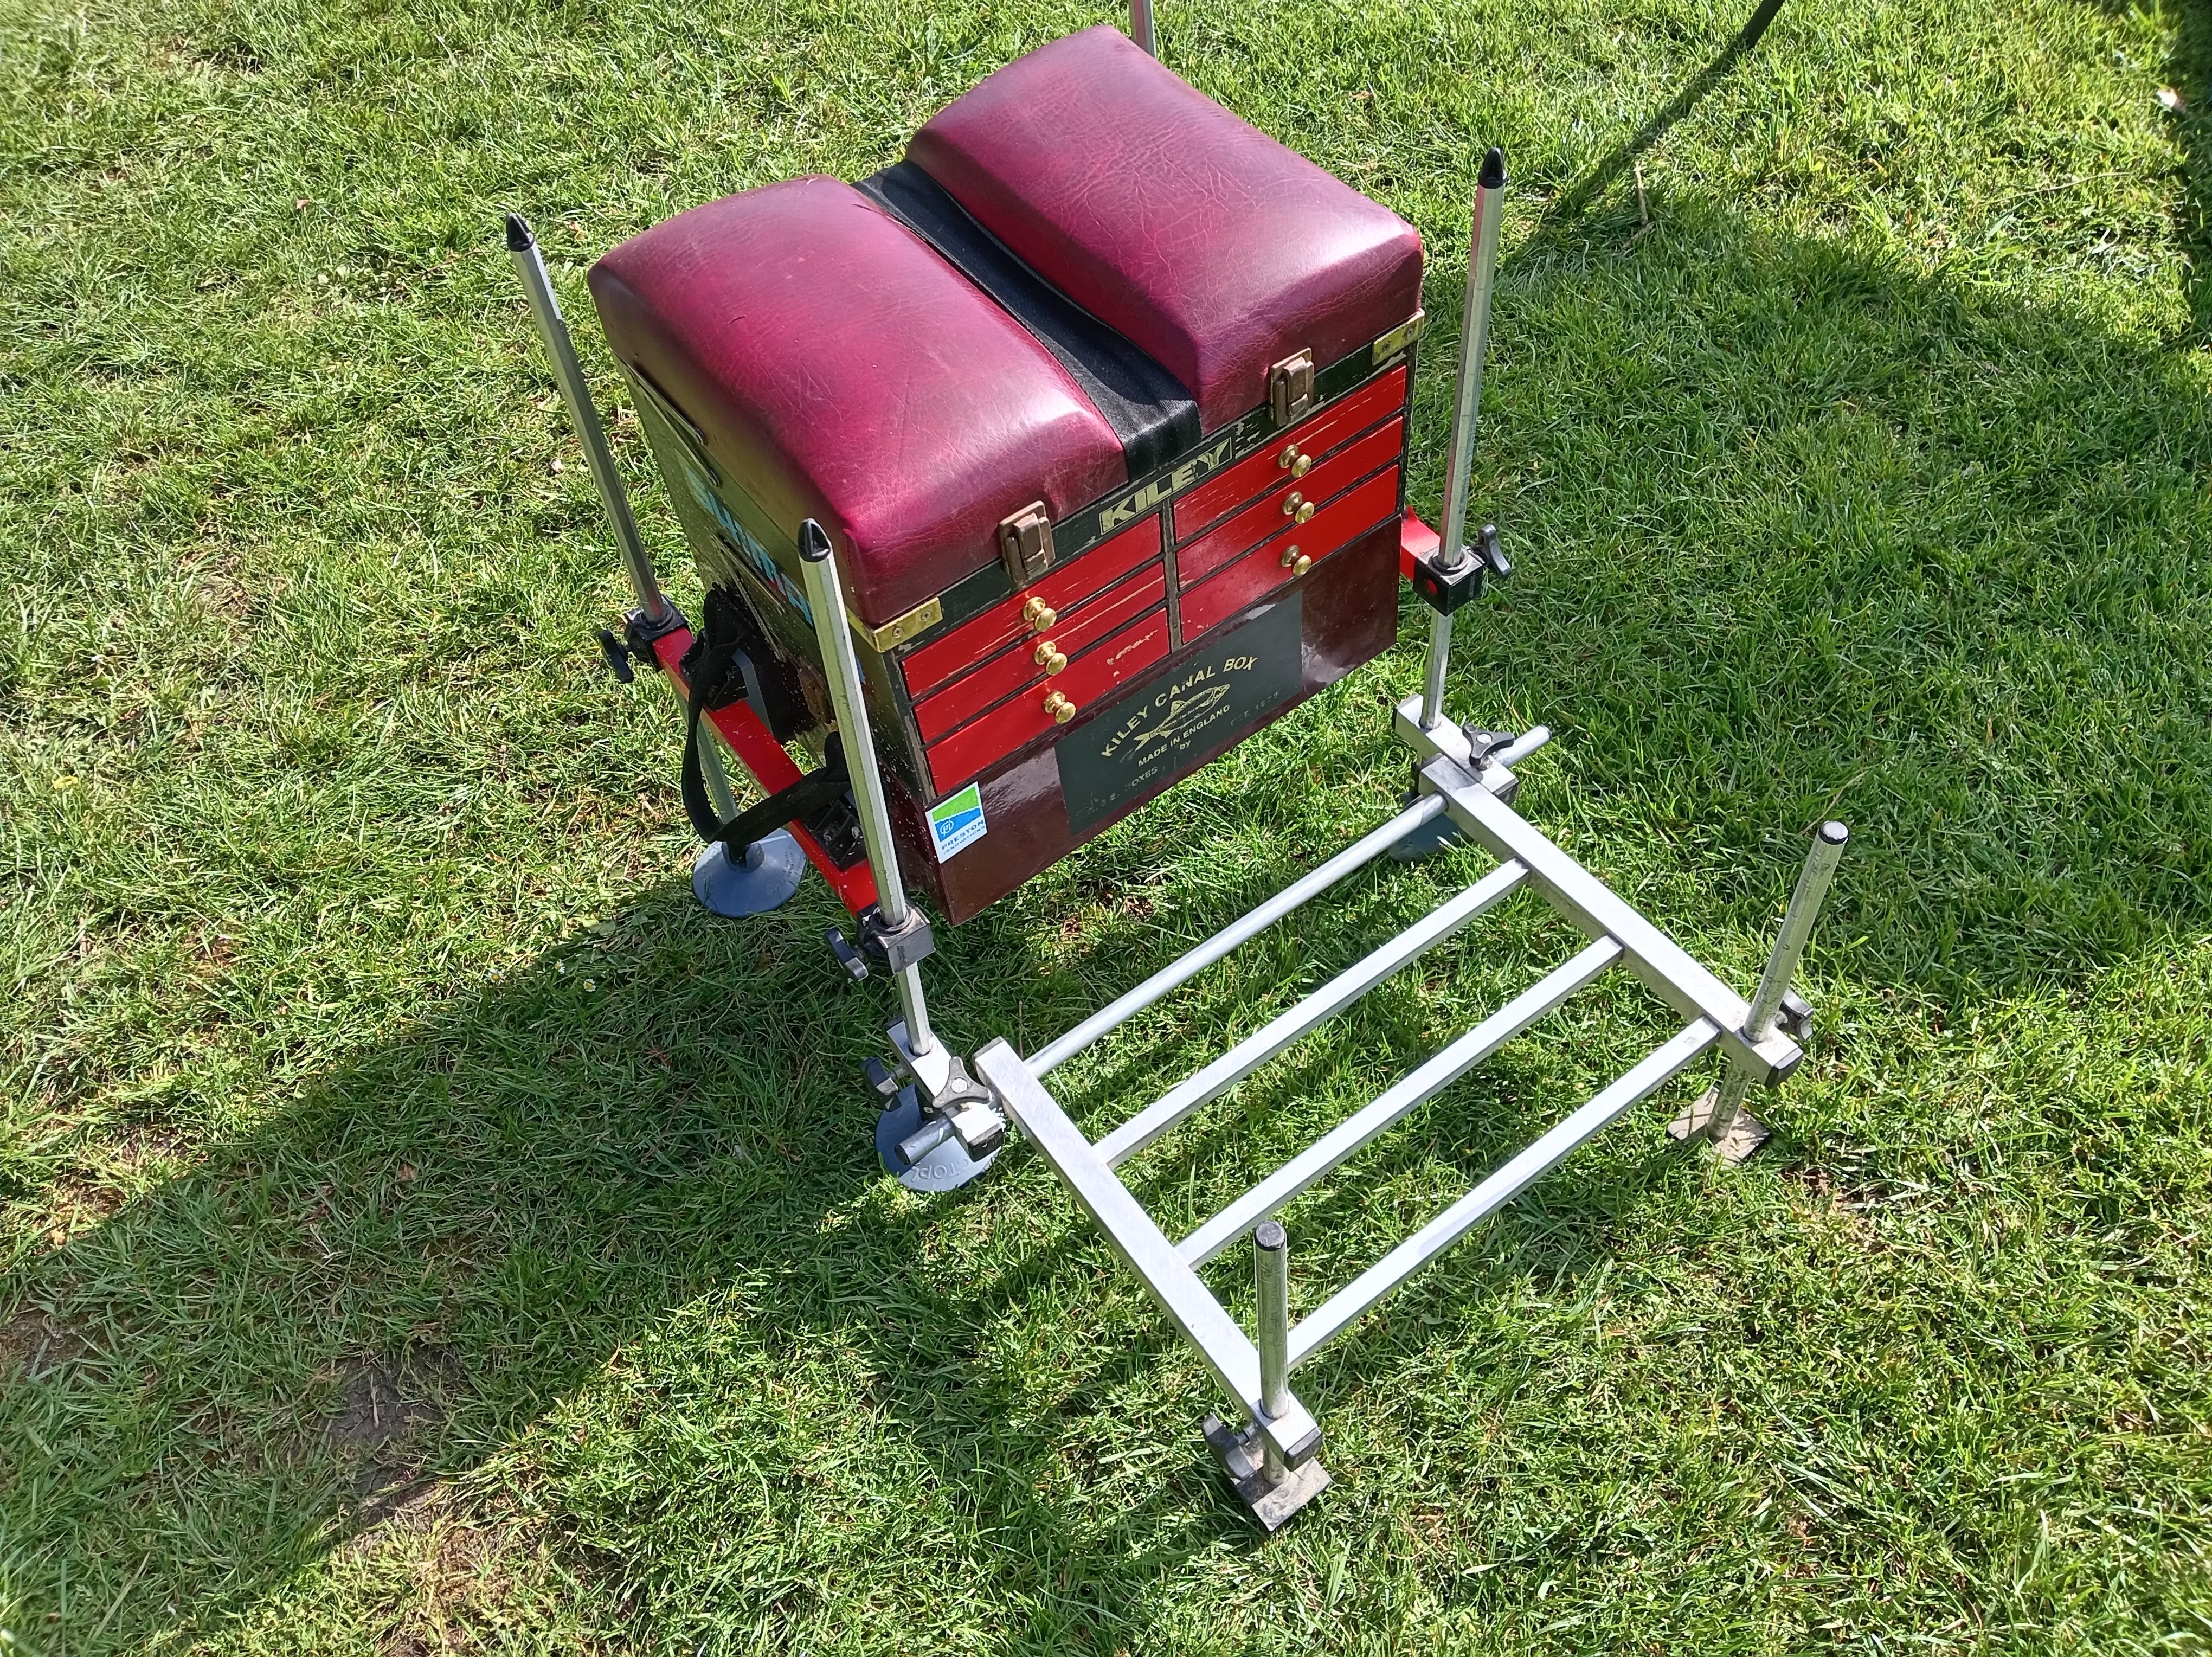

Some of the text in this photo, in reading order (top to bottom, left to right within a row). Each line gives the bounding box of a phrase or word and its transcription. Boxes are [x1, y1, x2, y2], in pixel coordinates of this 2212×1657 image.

[1101, 438, 1230, 533] KILEY
[683, 465, 821, 634] SHIMA
[1101, 656, 1258, 757] KILEY CANAL BOX
[1139, 744, 1168, 767] MADE
[1170, 736, 1180, 747] IN
[1183, 704, 1230, 739] ENGLAND
[1179, 740, 1191, 750] by
[942, 819, 984, 850] PRESTON
[943, 826, 985, 855] INNOVATIONS
[910, 1157, 971, 1183] CTOPL
